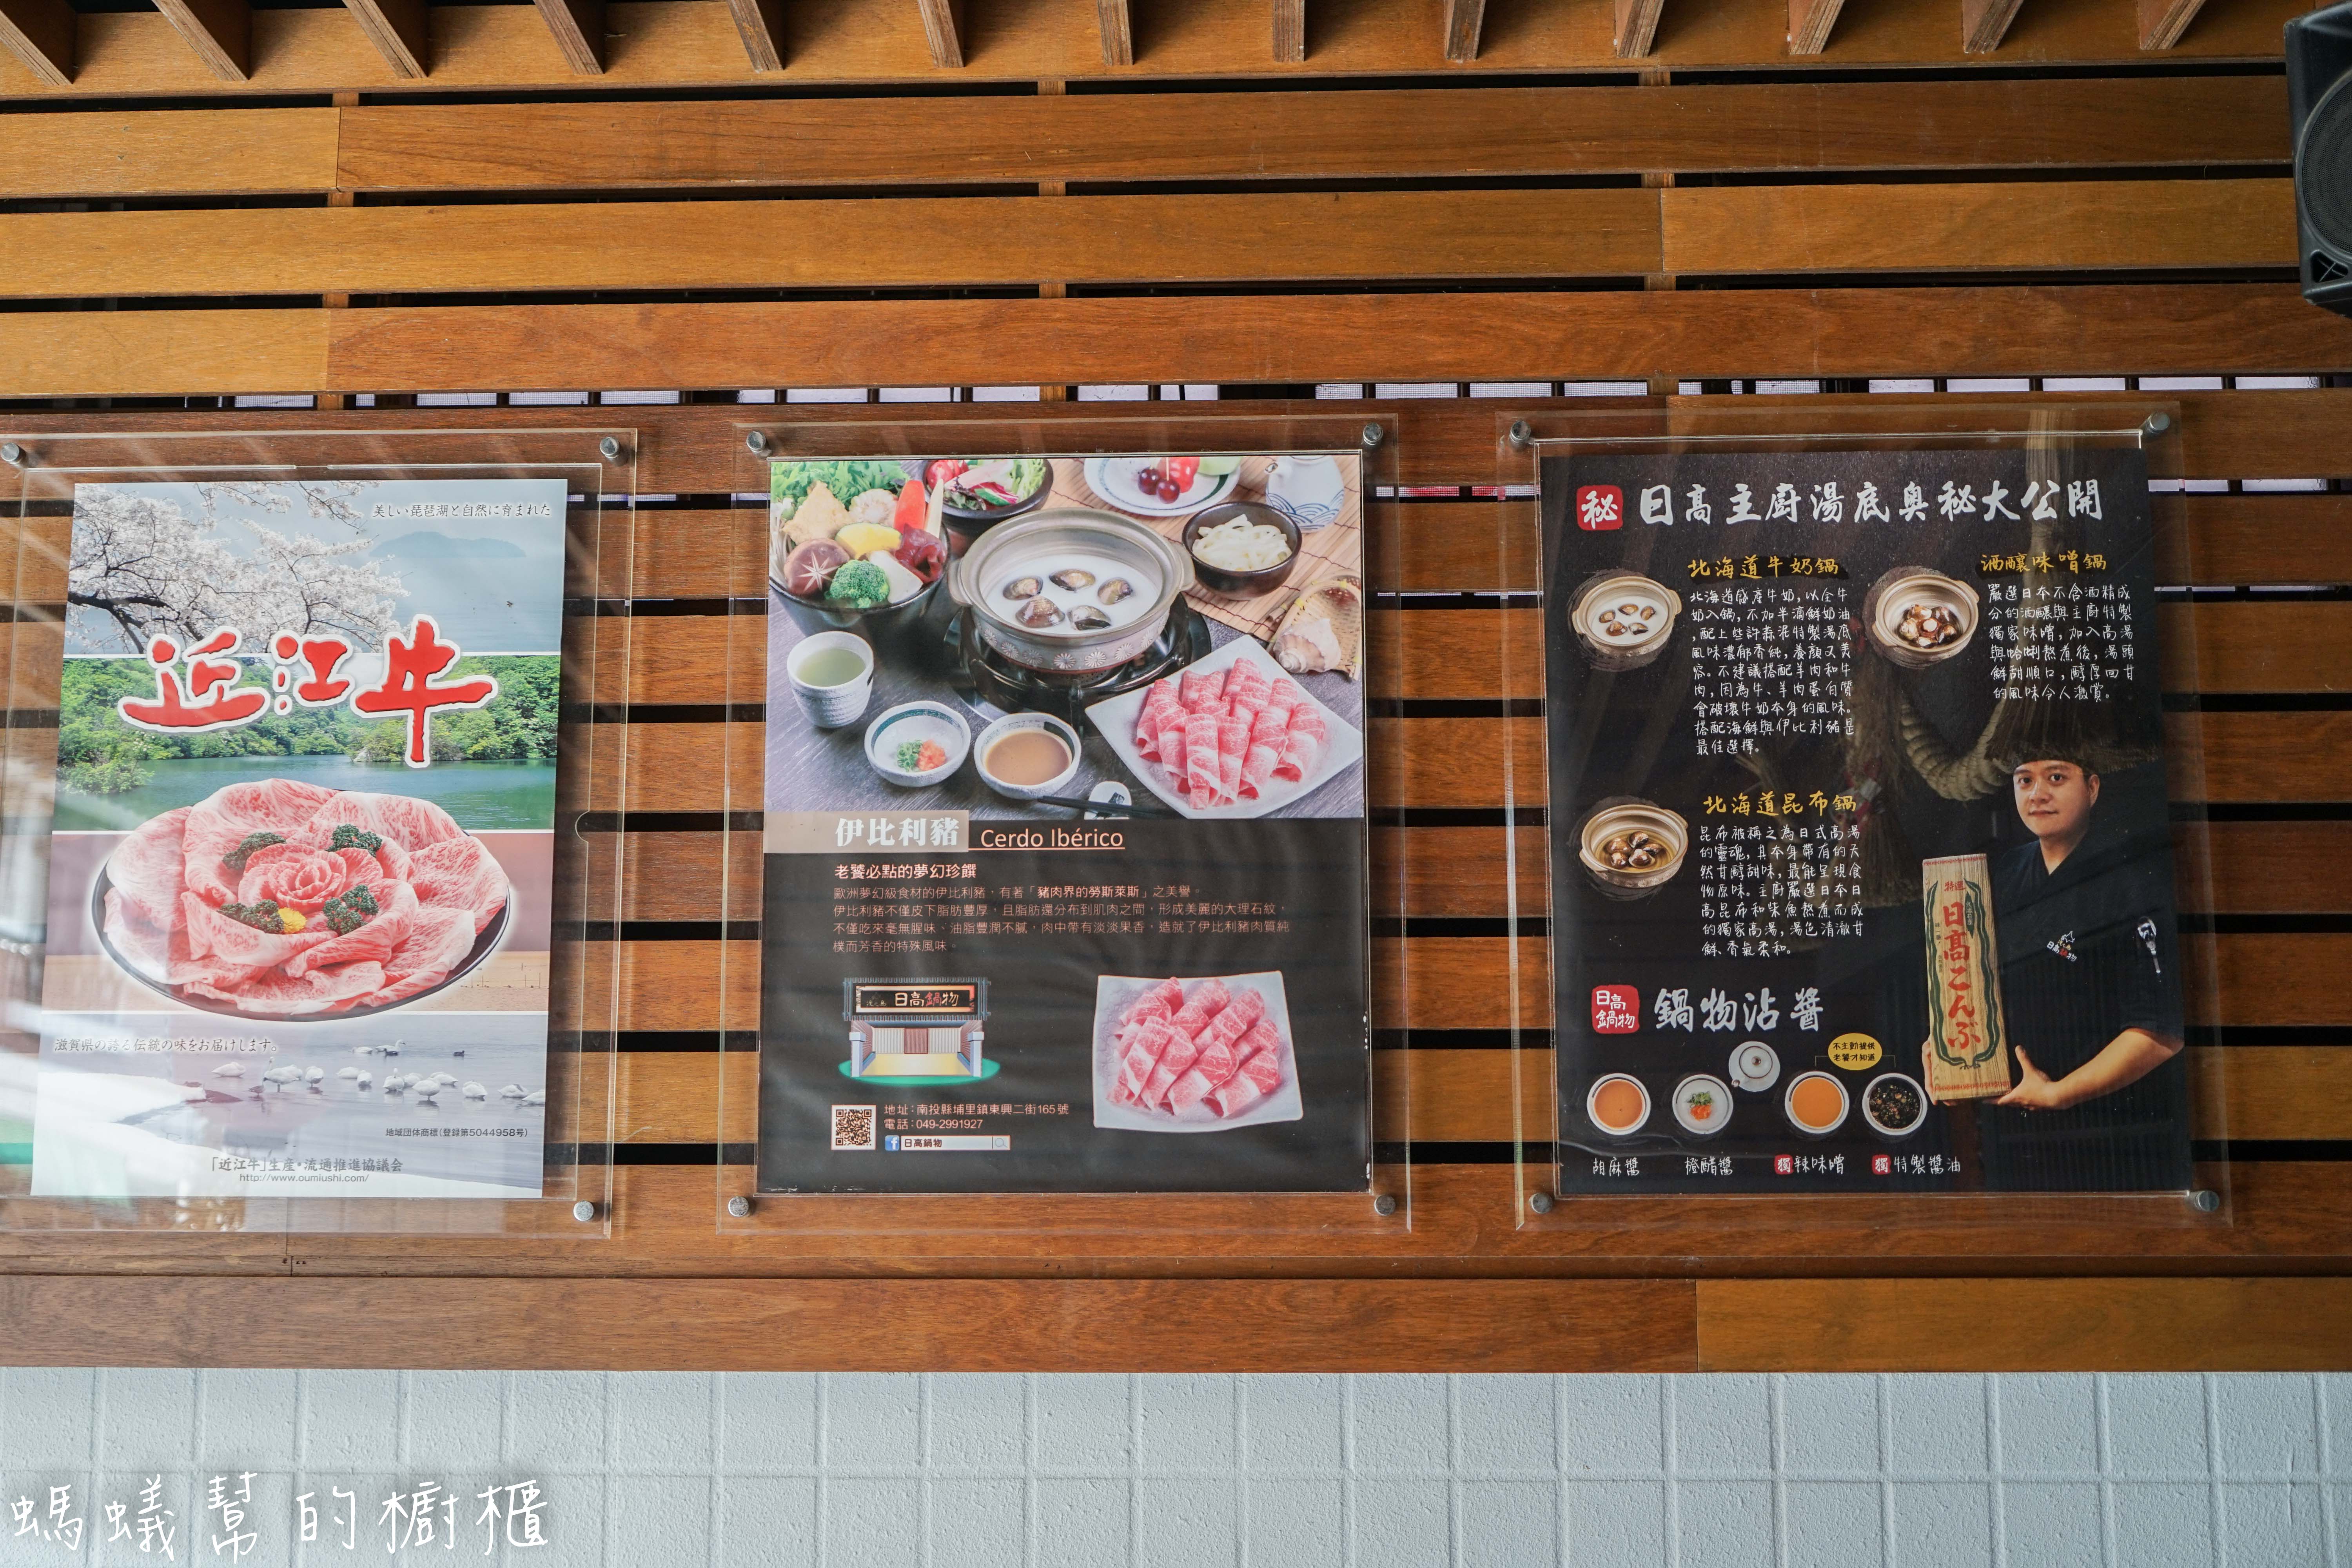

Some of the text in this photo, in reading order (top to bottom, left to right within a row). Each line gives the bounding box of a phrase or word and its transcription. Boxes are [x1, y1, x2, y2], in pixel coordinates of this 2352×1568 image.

[373, 504, 550, 517] 美しい琵琶湖と自然に育まれた
[1581, 492, 1619, 528] 秘
[1640, 479, 2103, 525] 日高主廚湯底奧秘大公開
[1688, 554, 1838, 579] 北海道牛奶鍋
[1988, 583, 2130, 603] 嚴選日本不含酒精成
[1988, 603, 2132, 621] 分的酒釀與主廚特製
[120, 618, 495, 764] 近江牛
[1697, 739, 1759, 755] 最佳選擇。
[1703, 790, 1856, 817] 北海道昆布鍋
[835, 817, 960, 848] 伊比利豬
[980, 826, 1124, 848] Cerdo Ibérico
[1700, 824, 1860, 841] 昆布被稱之為日式高湯
[834, 864, 976, 879] 老饕必點的夢幻珍饌
[1701, 900, 1863, 918] 高昆布和柴魚熬煮而成
[1943, 902, 1981, 1049] 日高こんぶ
[895, 991, 959, 1007] 日高鍋物
[1596, 990, 1626, 1010] 日高
[1595, 1009, 1635, 1029] 鍋物
[1653, 987, 1824, 1032] 鍋物沾醬
[54, 1038, 277, 1052] 滋賀県の誇る伝統の味をお届けします。
[1833, 1042, 1876, 1050] 不主動提供
[904, 1139, 942, 1148] 日高鍋物
[1592, 1156, 1640, 1176] 胡麻醬
[1685, 1156, 1733, 1176] 橙醋醬
[1794, 1154, 1844, 1175] 辣味噌
[1894, 1156, 1961, 1175] 特製醬油
[240, 1173, 369, 1183] http://www.oumiushi.com/
